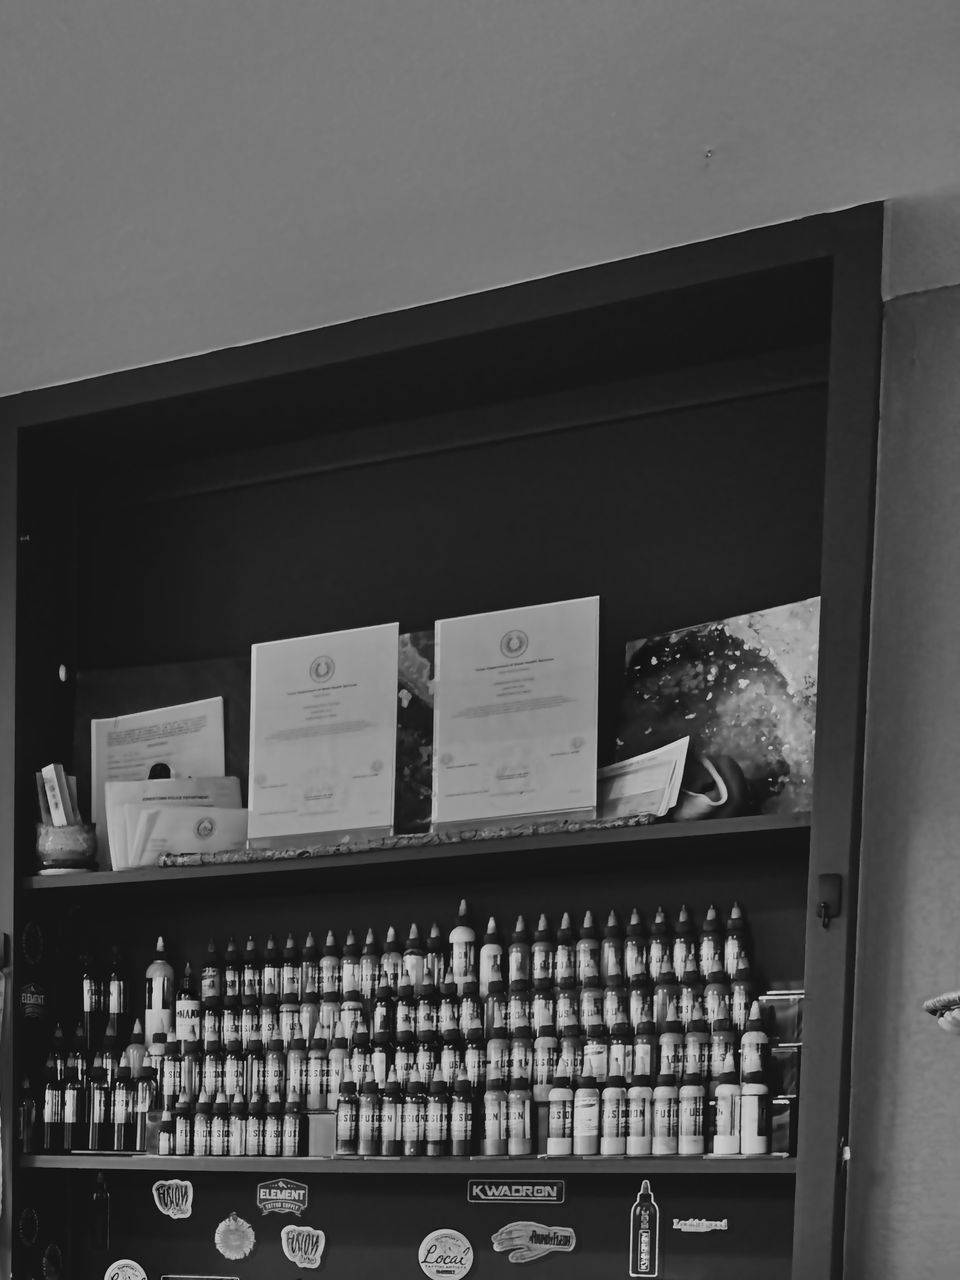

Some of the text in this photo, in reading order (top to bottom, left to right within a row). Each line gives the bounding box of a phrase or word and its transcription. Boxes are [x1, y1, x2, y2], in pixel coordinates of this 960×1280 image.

[259, 1188, 306, 1201] ELEMENT
[472, 1184, 557, 1200] KWADRON
[421, 1244, 470, 1266] Local
